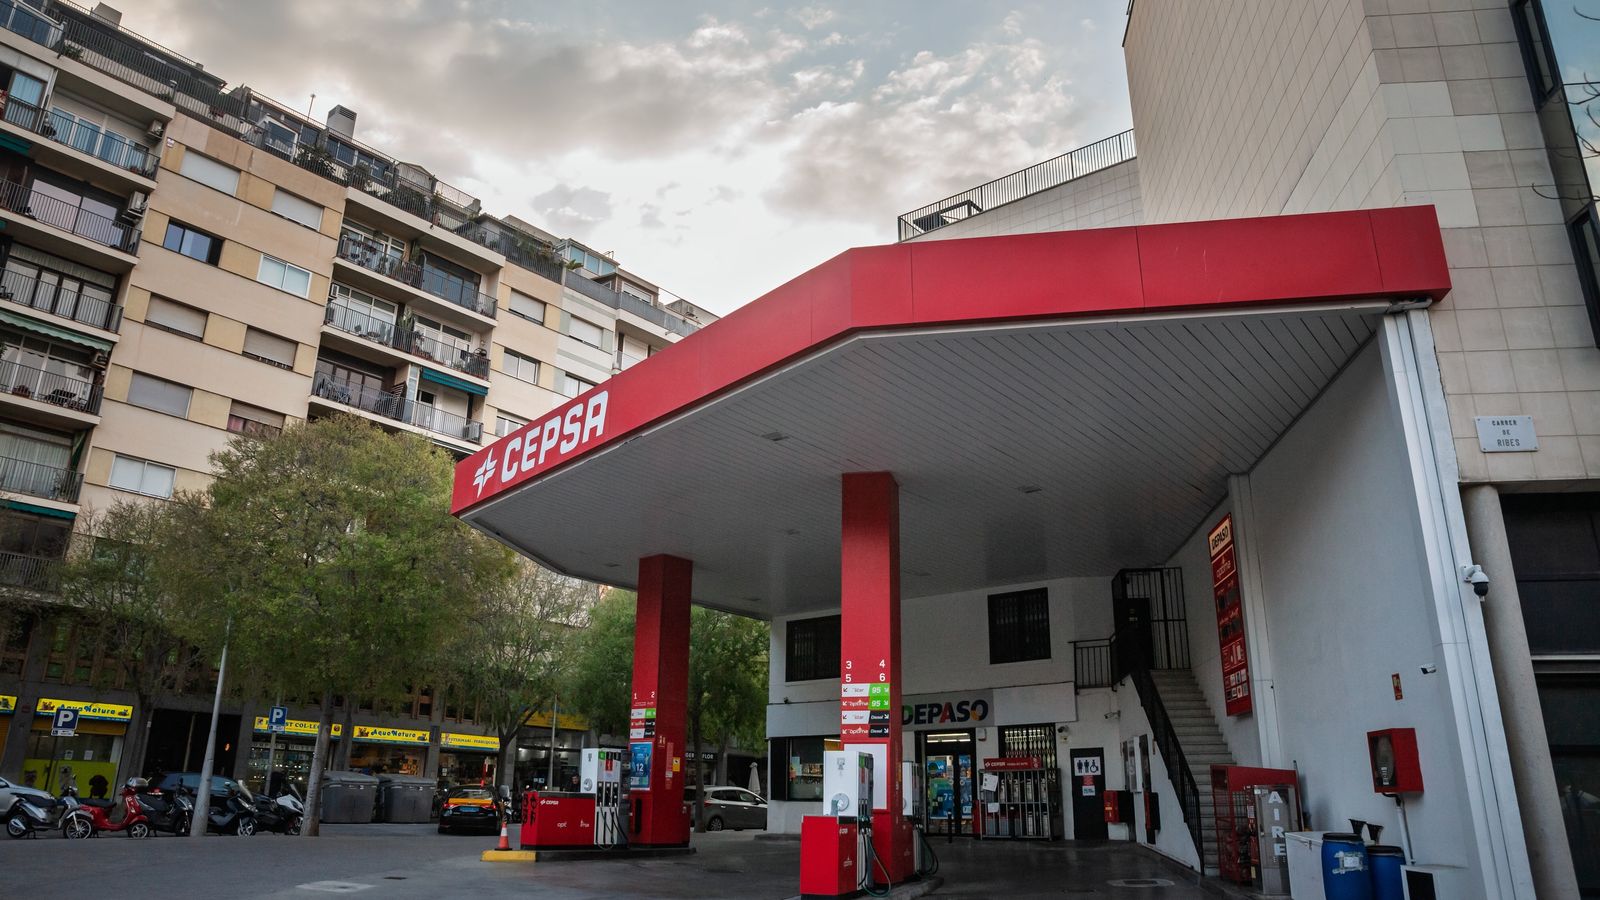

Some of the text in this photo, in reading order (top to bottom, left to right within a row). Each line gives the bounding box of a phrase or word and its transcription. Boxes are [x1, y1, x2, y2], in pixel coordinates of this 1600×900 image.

[501, 390, 609, 483] CEPSA
[1497, 438, 1520, 447] RIBES
[1212, 526, 1229, 550] DEPASO
[846, 659, 886, 670] 3 4
[845, 672, 886, 683] 5 6
[871, 686, 881, 694] 95
[633, 692, 638, 700] 1
[871, 699, 881, 708] 95
[57, 710, 74, 727] P
[272, 708, 284, 723] P
[902, 700, 988, 726] DEPASO
[635, 763, 644, 772] 12
[1268, 790, 1287, 856] AIRE
